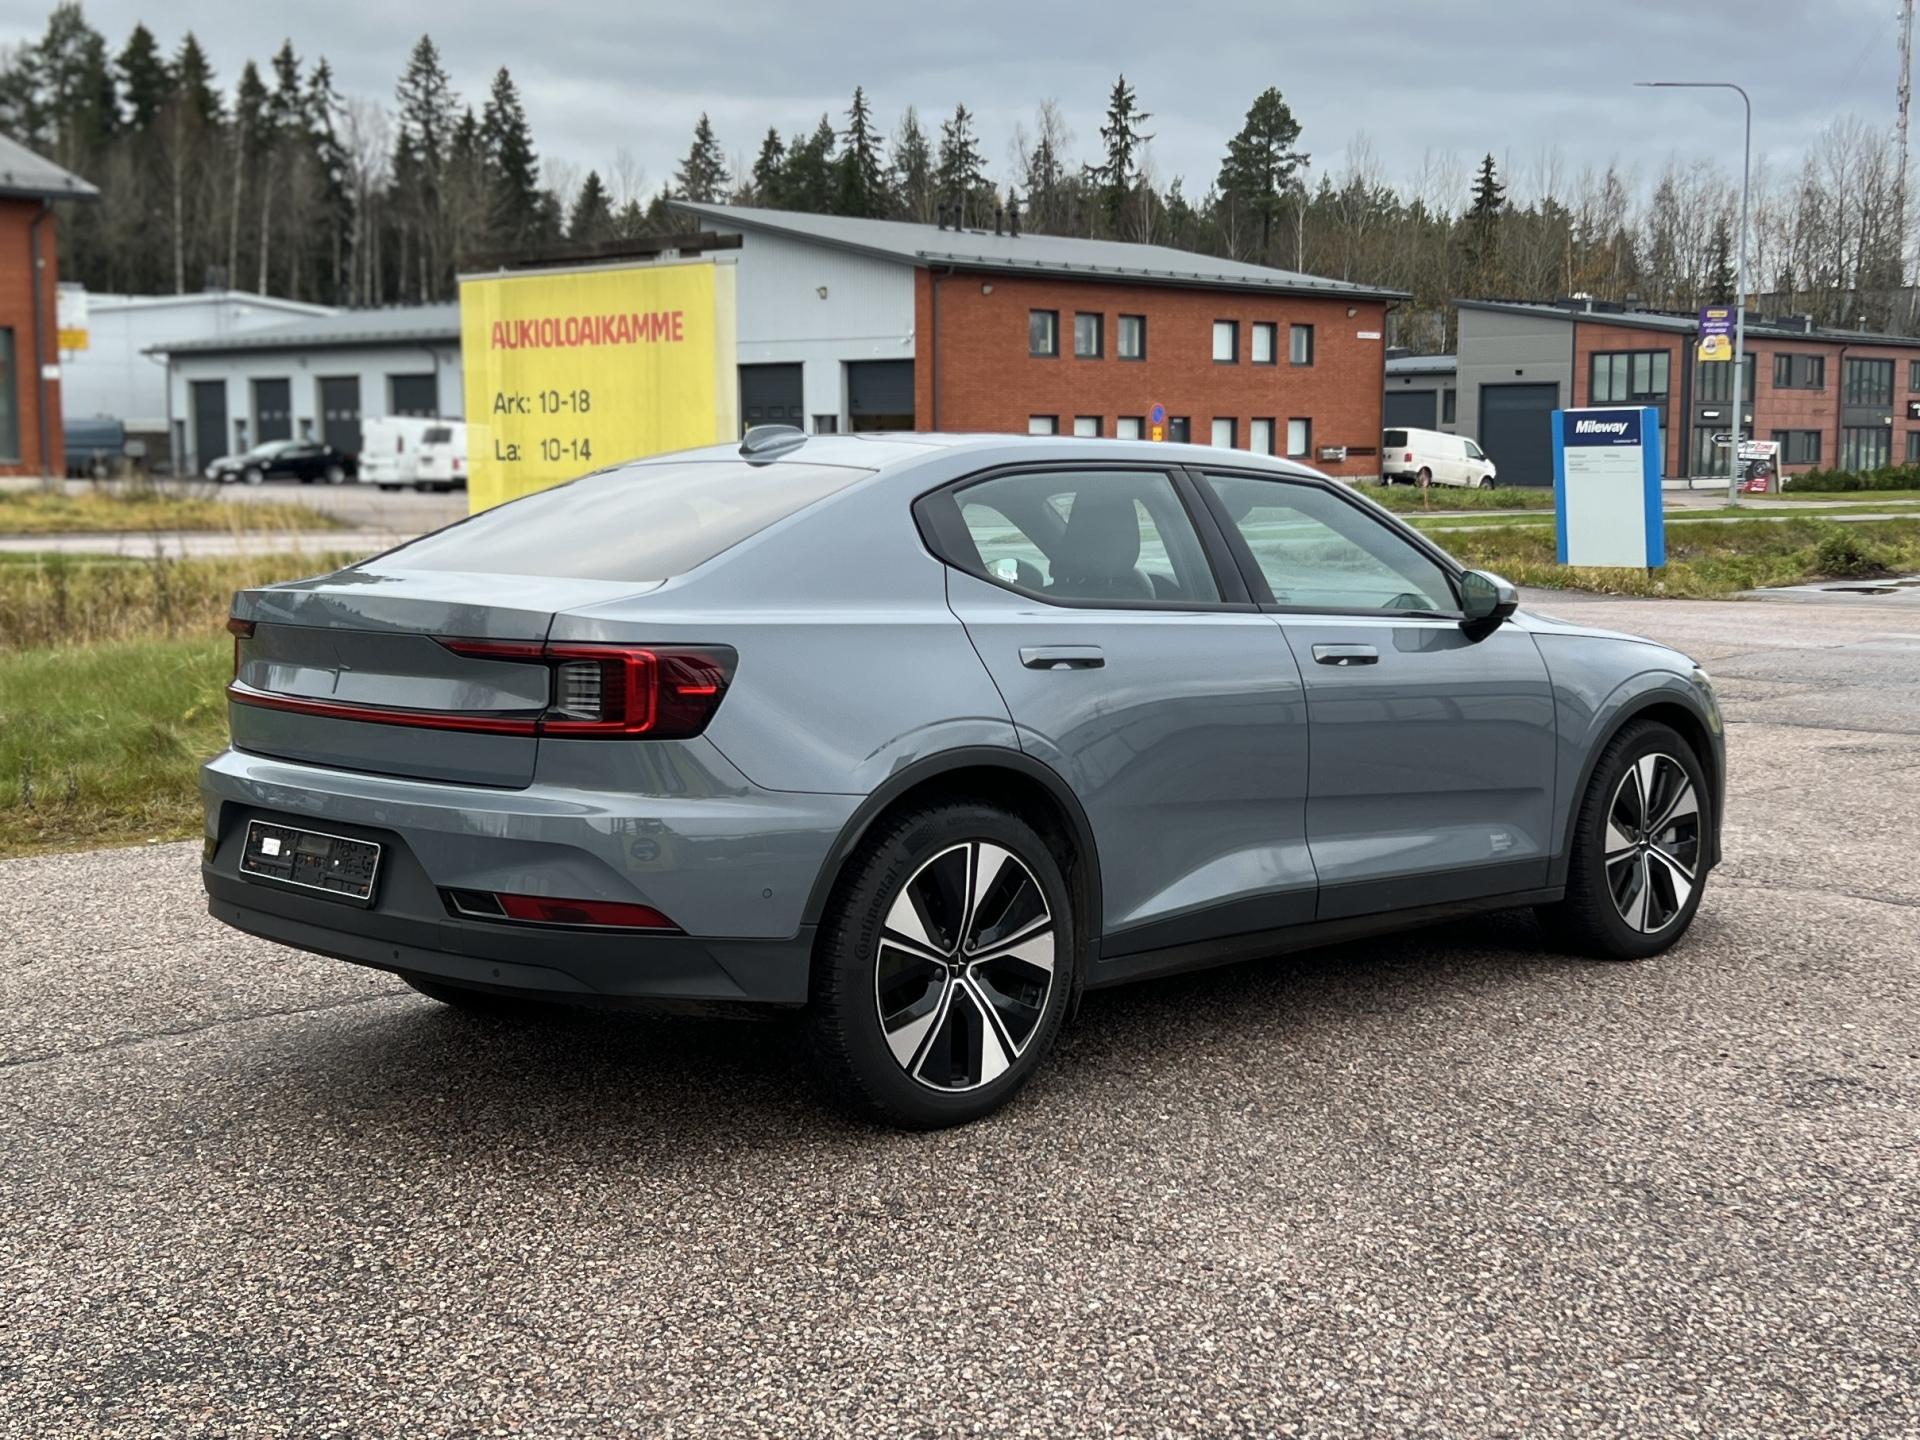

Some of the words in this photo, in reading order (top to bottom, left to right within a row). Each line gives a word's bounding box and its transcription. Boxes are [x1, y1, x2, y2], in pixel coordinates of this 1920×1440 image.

[491, 311, 684, 350] AUKIOLOAIKAMME
[493, 390, 531, 414] Ark:
[539, 389, 591, 413] 10-18
[1575, 420, 1628, 435] Mileway
[495, 439, 521, 461] La:
[541, 438, 592, 461] 10-14
[854, 866, 898, 961] Continental
